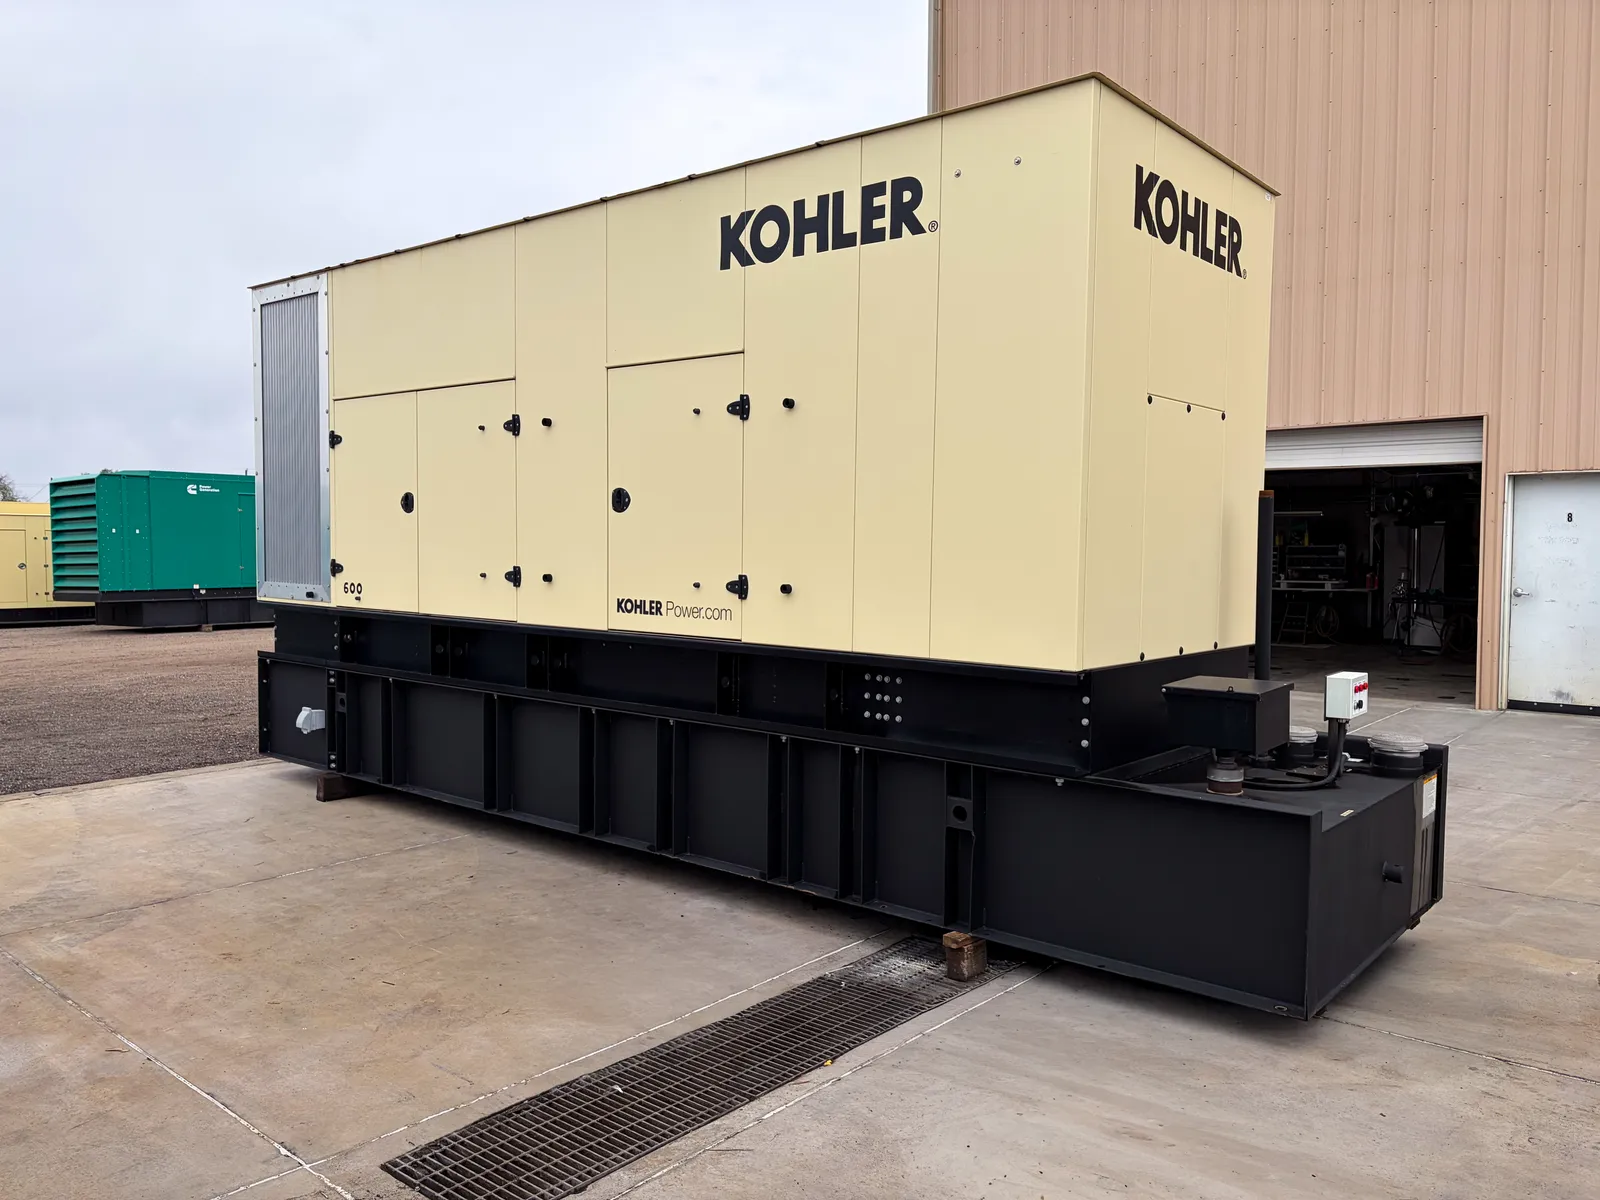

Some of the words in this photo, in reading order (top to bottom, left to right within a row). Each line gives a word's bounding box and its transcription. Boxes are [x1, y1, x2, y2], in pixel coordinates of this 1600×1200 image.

[1567, 512, 1573, 523] 8
[343, 582, 363, 594] 600
[616, 598, 663, 616] KOHLER
[665, 600, 733, 621] Power.com
